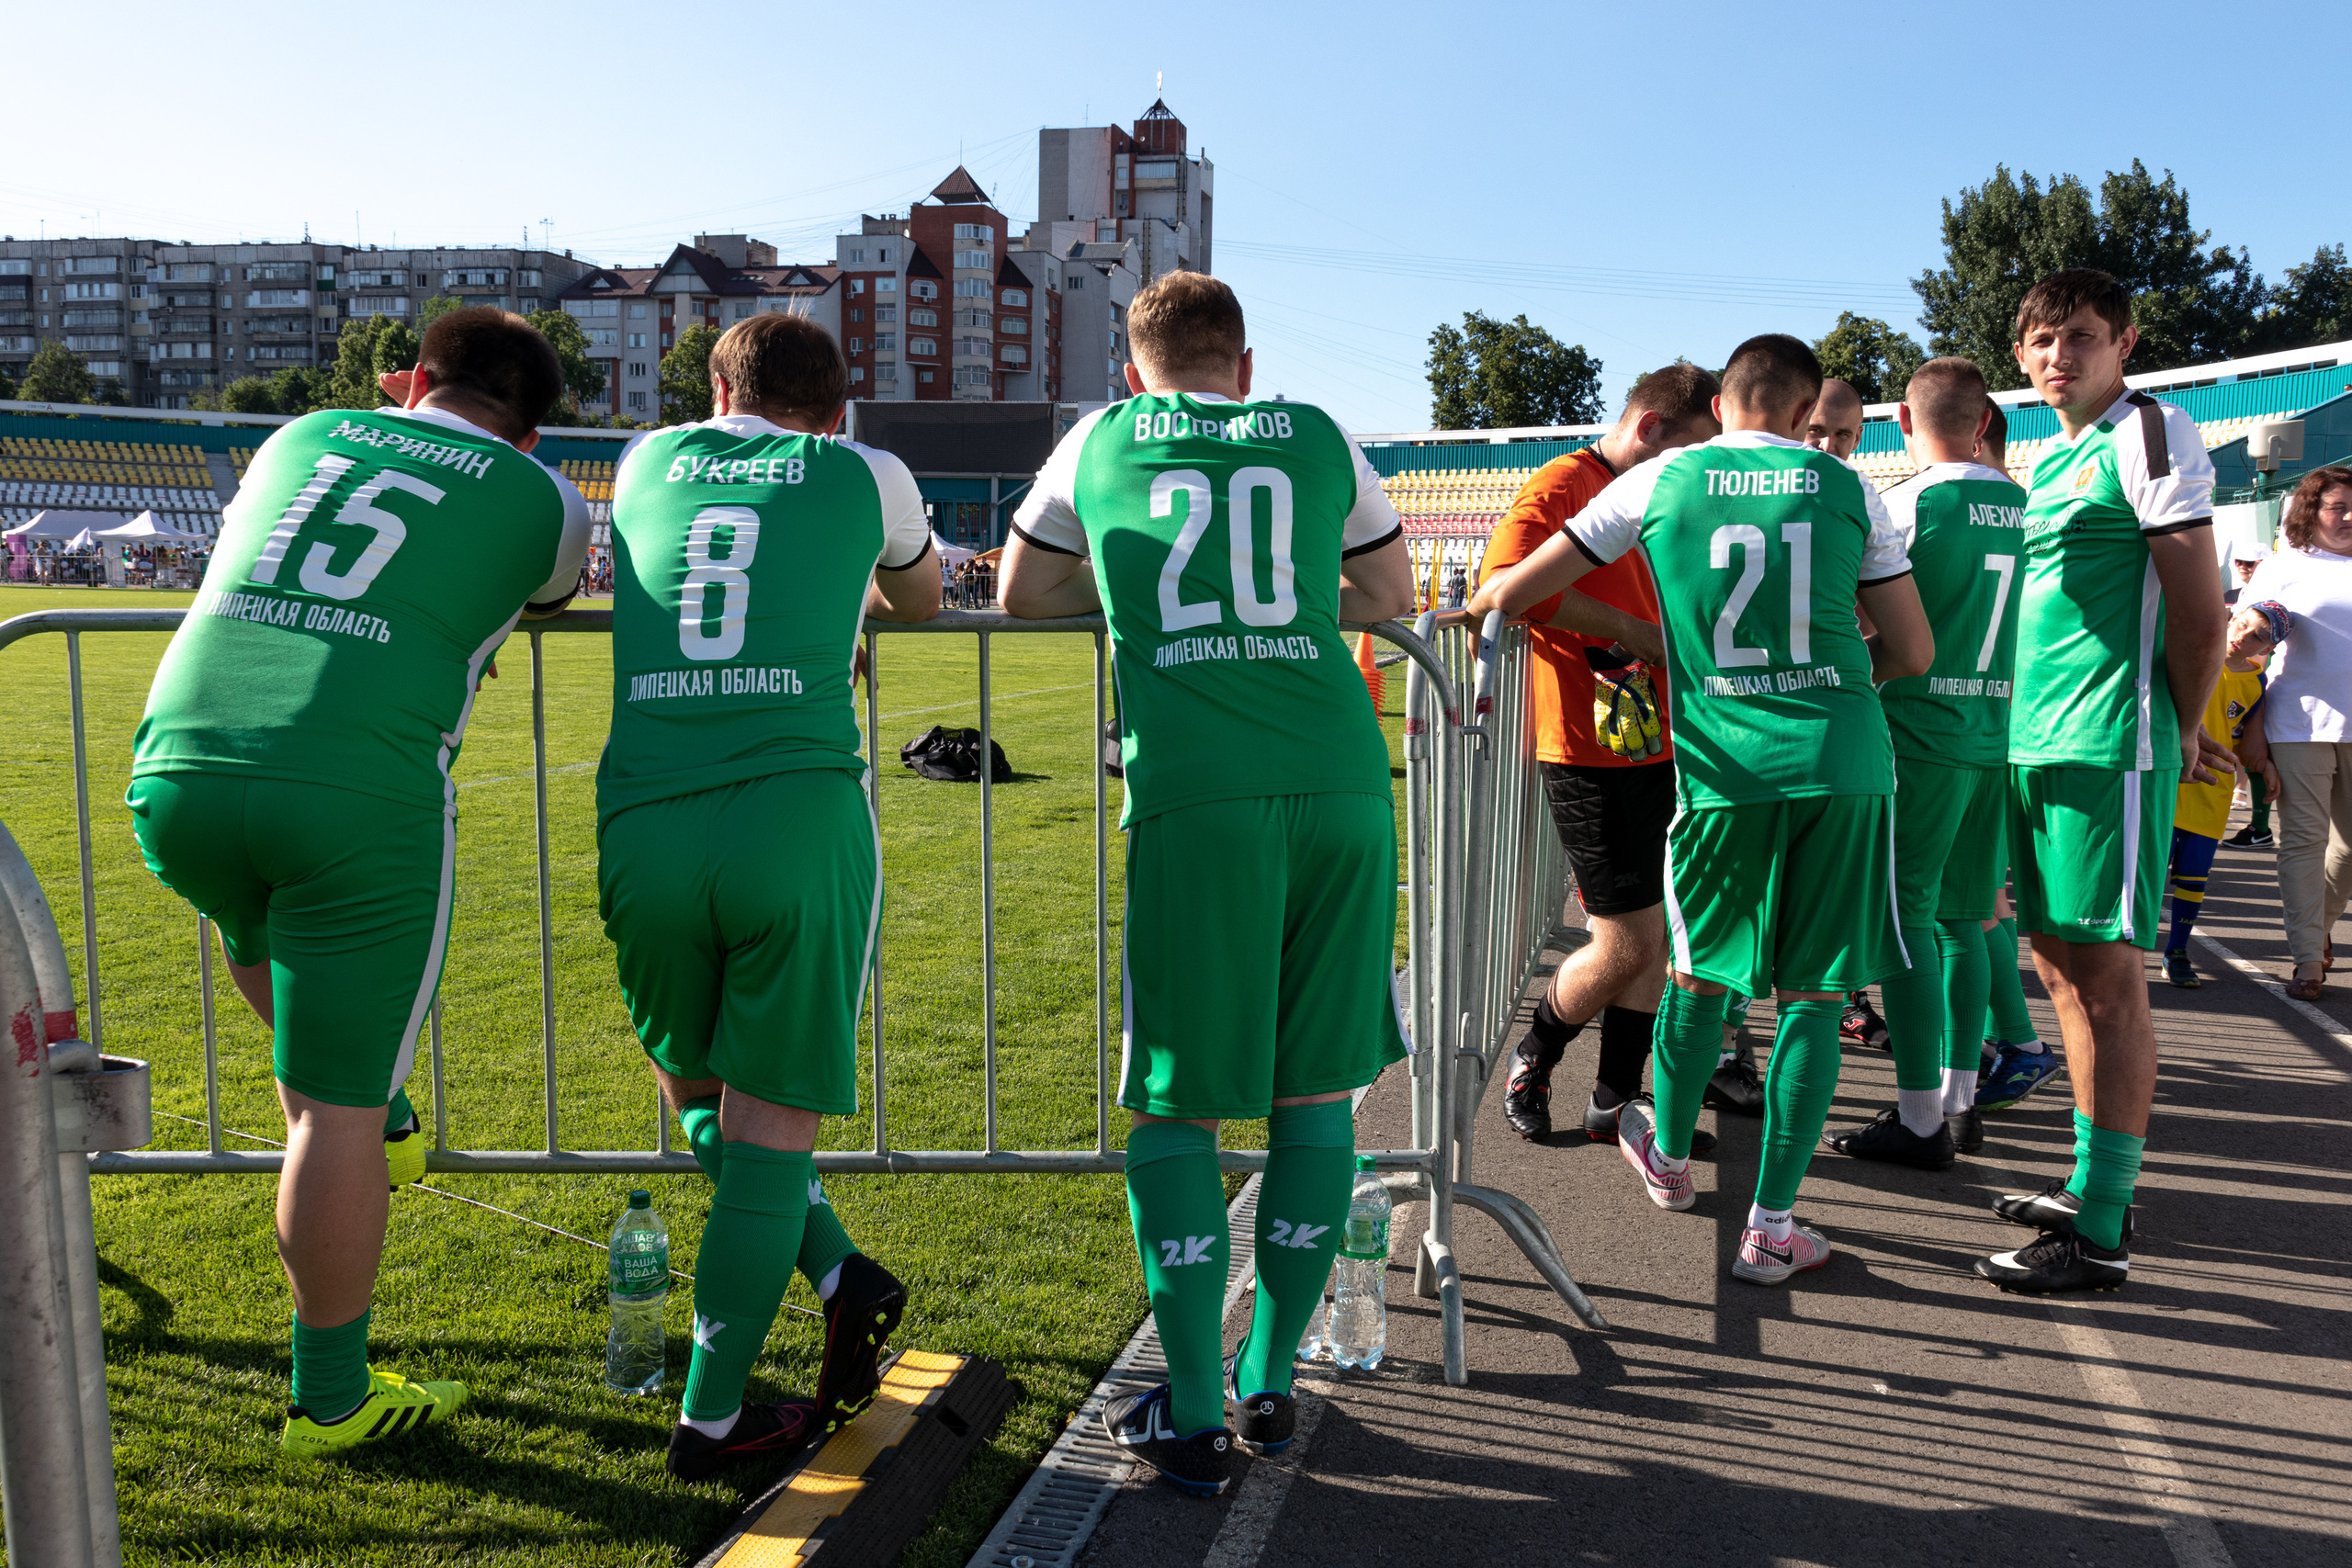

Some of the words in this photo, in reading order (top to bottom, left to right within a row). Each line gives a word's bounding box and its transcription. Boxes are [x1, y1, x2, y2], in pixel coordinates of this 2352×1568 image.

[1134, 411, 1294, 441] ВОСТРИКОВ
[328, 420, 494, 479] МАРИНИН
[665, 456, 805, 484] БУКРЕЕВ
[1705, 468, 1819, 495] ТЮЛЕНЕВ
[250, 454, 447, 601] 15
[1149, 466, 1298, 632] 20
[678, 506, 761, 660] 8
[1710, 522, 1812, 668] 21
[205, 591, 302, 627] ЛИПЕЦКАЯ
[304, 604, 391, 643] ОБЛАСТЬ
[1976, 554, 2016, 672] 7
[1153, 636, 1238, 668] ЛИПЕЦКАЯ
[1244, 636, 1318, 660] ОБЛАСТЬ
[628, 670, 713, 702] ЛИПЕЦКАЯ
[721, 668, 803, 694] ОБЛАСТЬ
[1704, 674, 1773, 696] ЛИПЕЦКАЯ
[1776, 666, 1841, 693] ОБЛАСТЬ
[1266, 1218, 1330, 1248] 2K
[625, 1256, 658, 1269] ВАША
[1160, 1235, 1216, 1267] 2K
[626, 1266, 659, 1278] ВОДА
[301, 1435, 329, 1446] COPA
